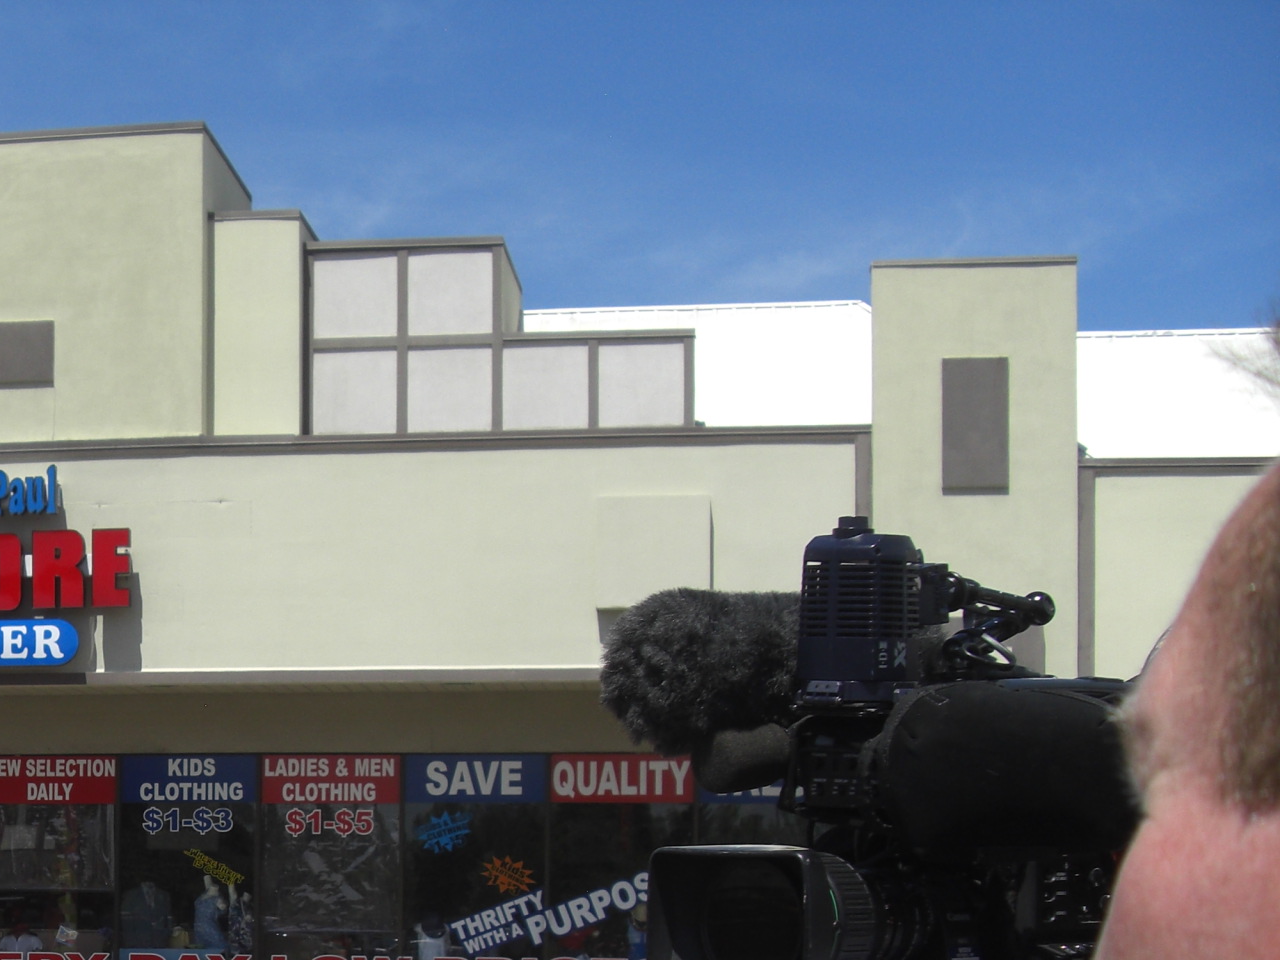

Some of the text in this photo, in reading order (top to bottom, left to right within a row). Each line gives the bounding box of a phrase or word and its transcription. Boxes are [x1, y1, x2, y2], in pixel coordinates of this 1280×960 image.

[25, 759, 116, 778] SELECTION
[167, 758, 216, 777] KIDS
[264, 758, 395, 777] LADIES & MEN
[426, 760, 523, 796] SAVE
[552, 760, 691, 799] QUALITY
[27, 782, 73, 802] DAILY
[139, 782, 244, 801] CLOTHING
[282, 782, 376, 801] CLOTHING
[142, 807, 234, 835] $1-$3
[285, 808, 374, 838] $1-$5
[451, 890, 543, 940] THRIFTY
[525, 872, 649, 945] PURPOS
[463, 922, 524, 954] WITH A
